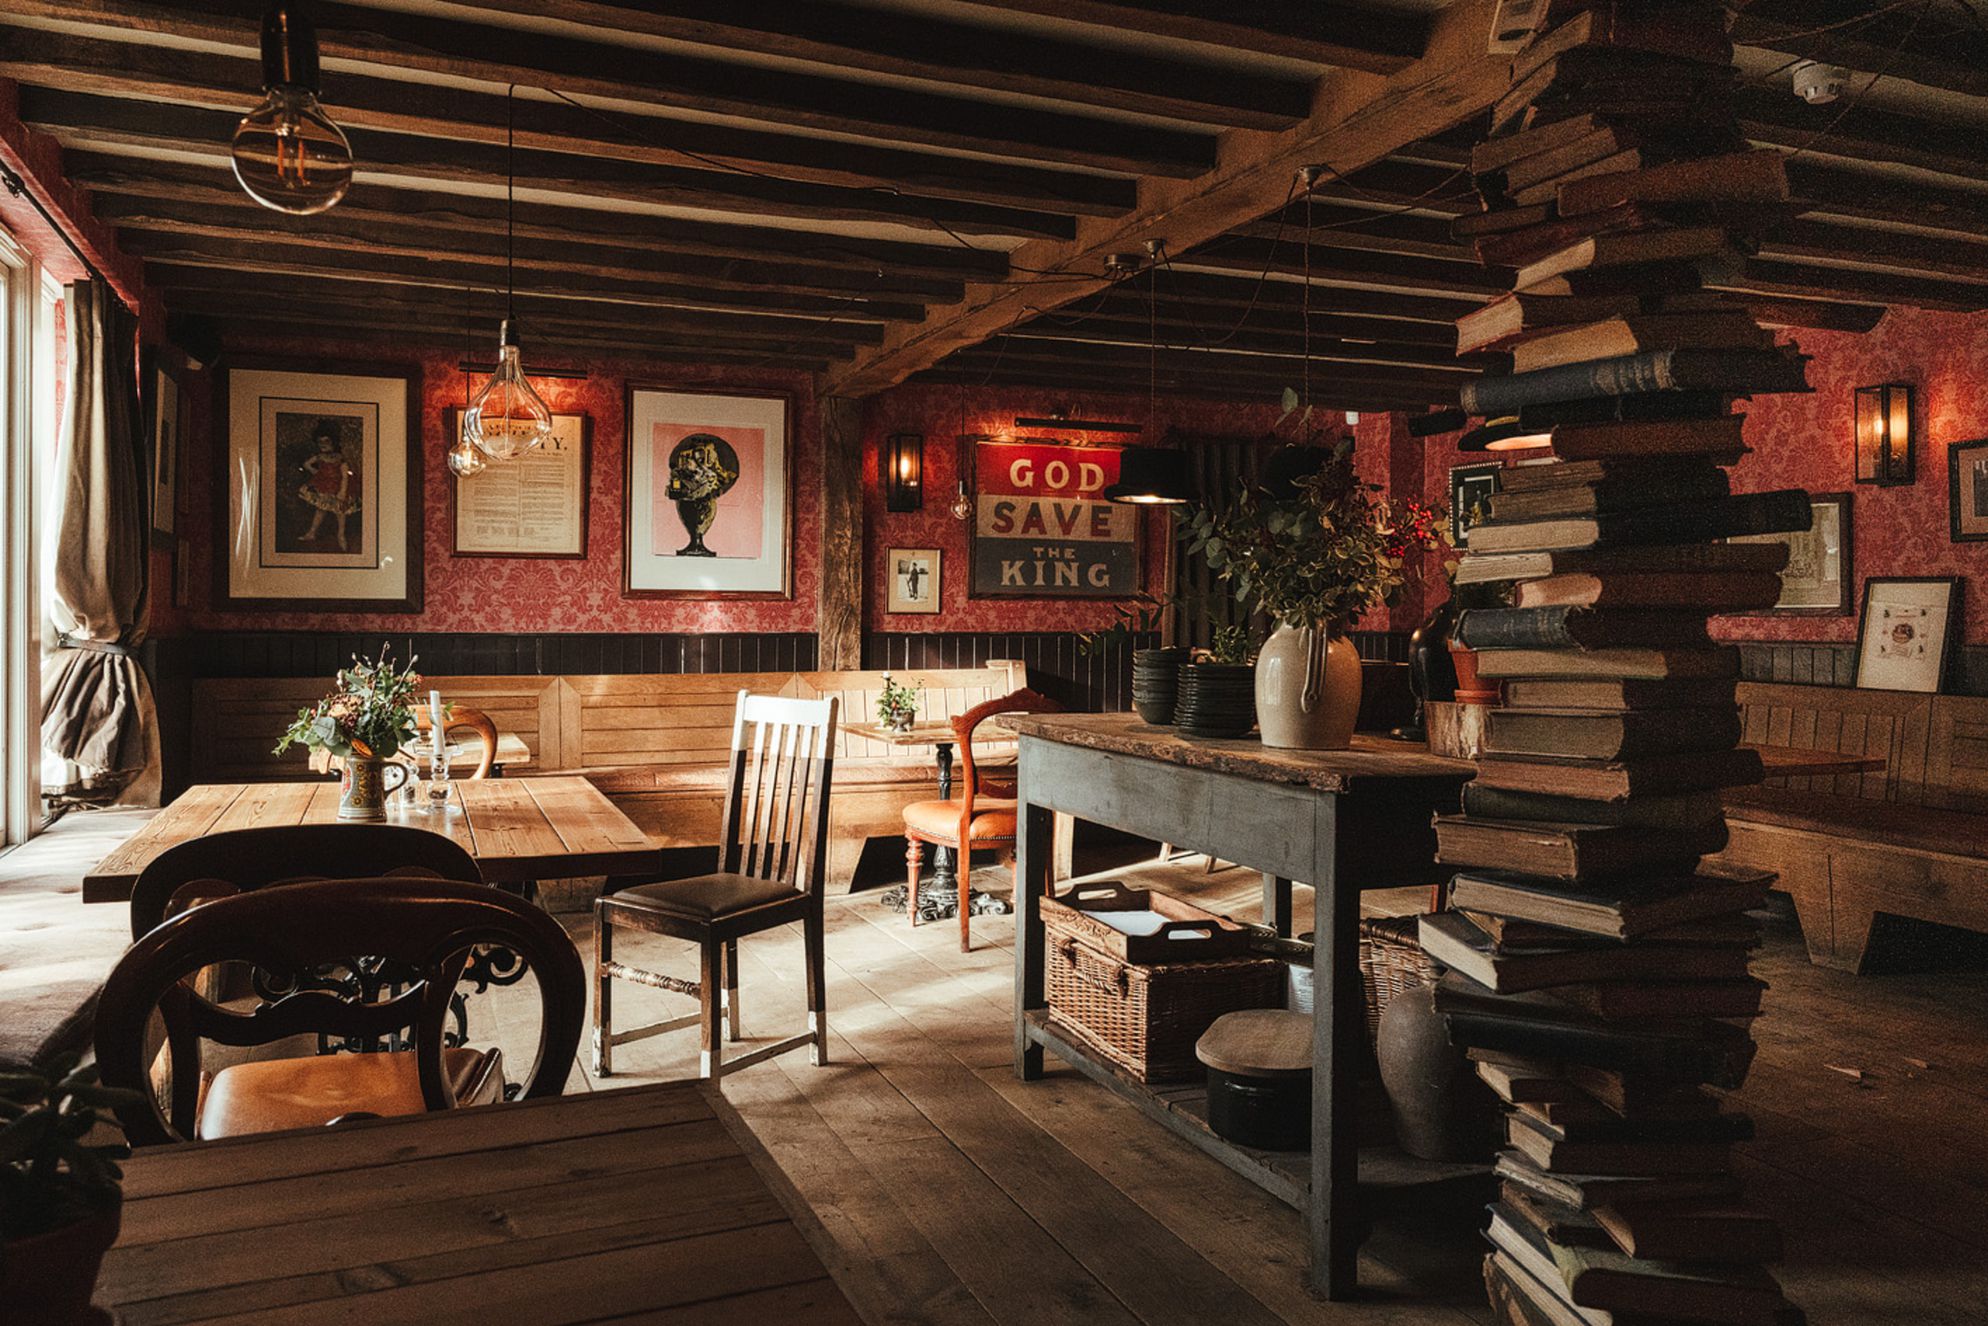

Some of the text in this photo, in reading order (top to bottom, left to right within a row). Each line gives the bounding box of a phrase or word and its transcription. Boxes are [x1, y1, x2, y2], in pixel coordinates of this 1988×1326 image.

[1009, 458, 1104, 492] GOD
[991, 501, 1113, 538] SAVE
[1032, 547, 1076, 559] THE
[1000, 560, 1111, 588] KING
